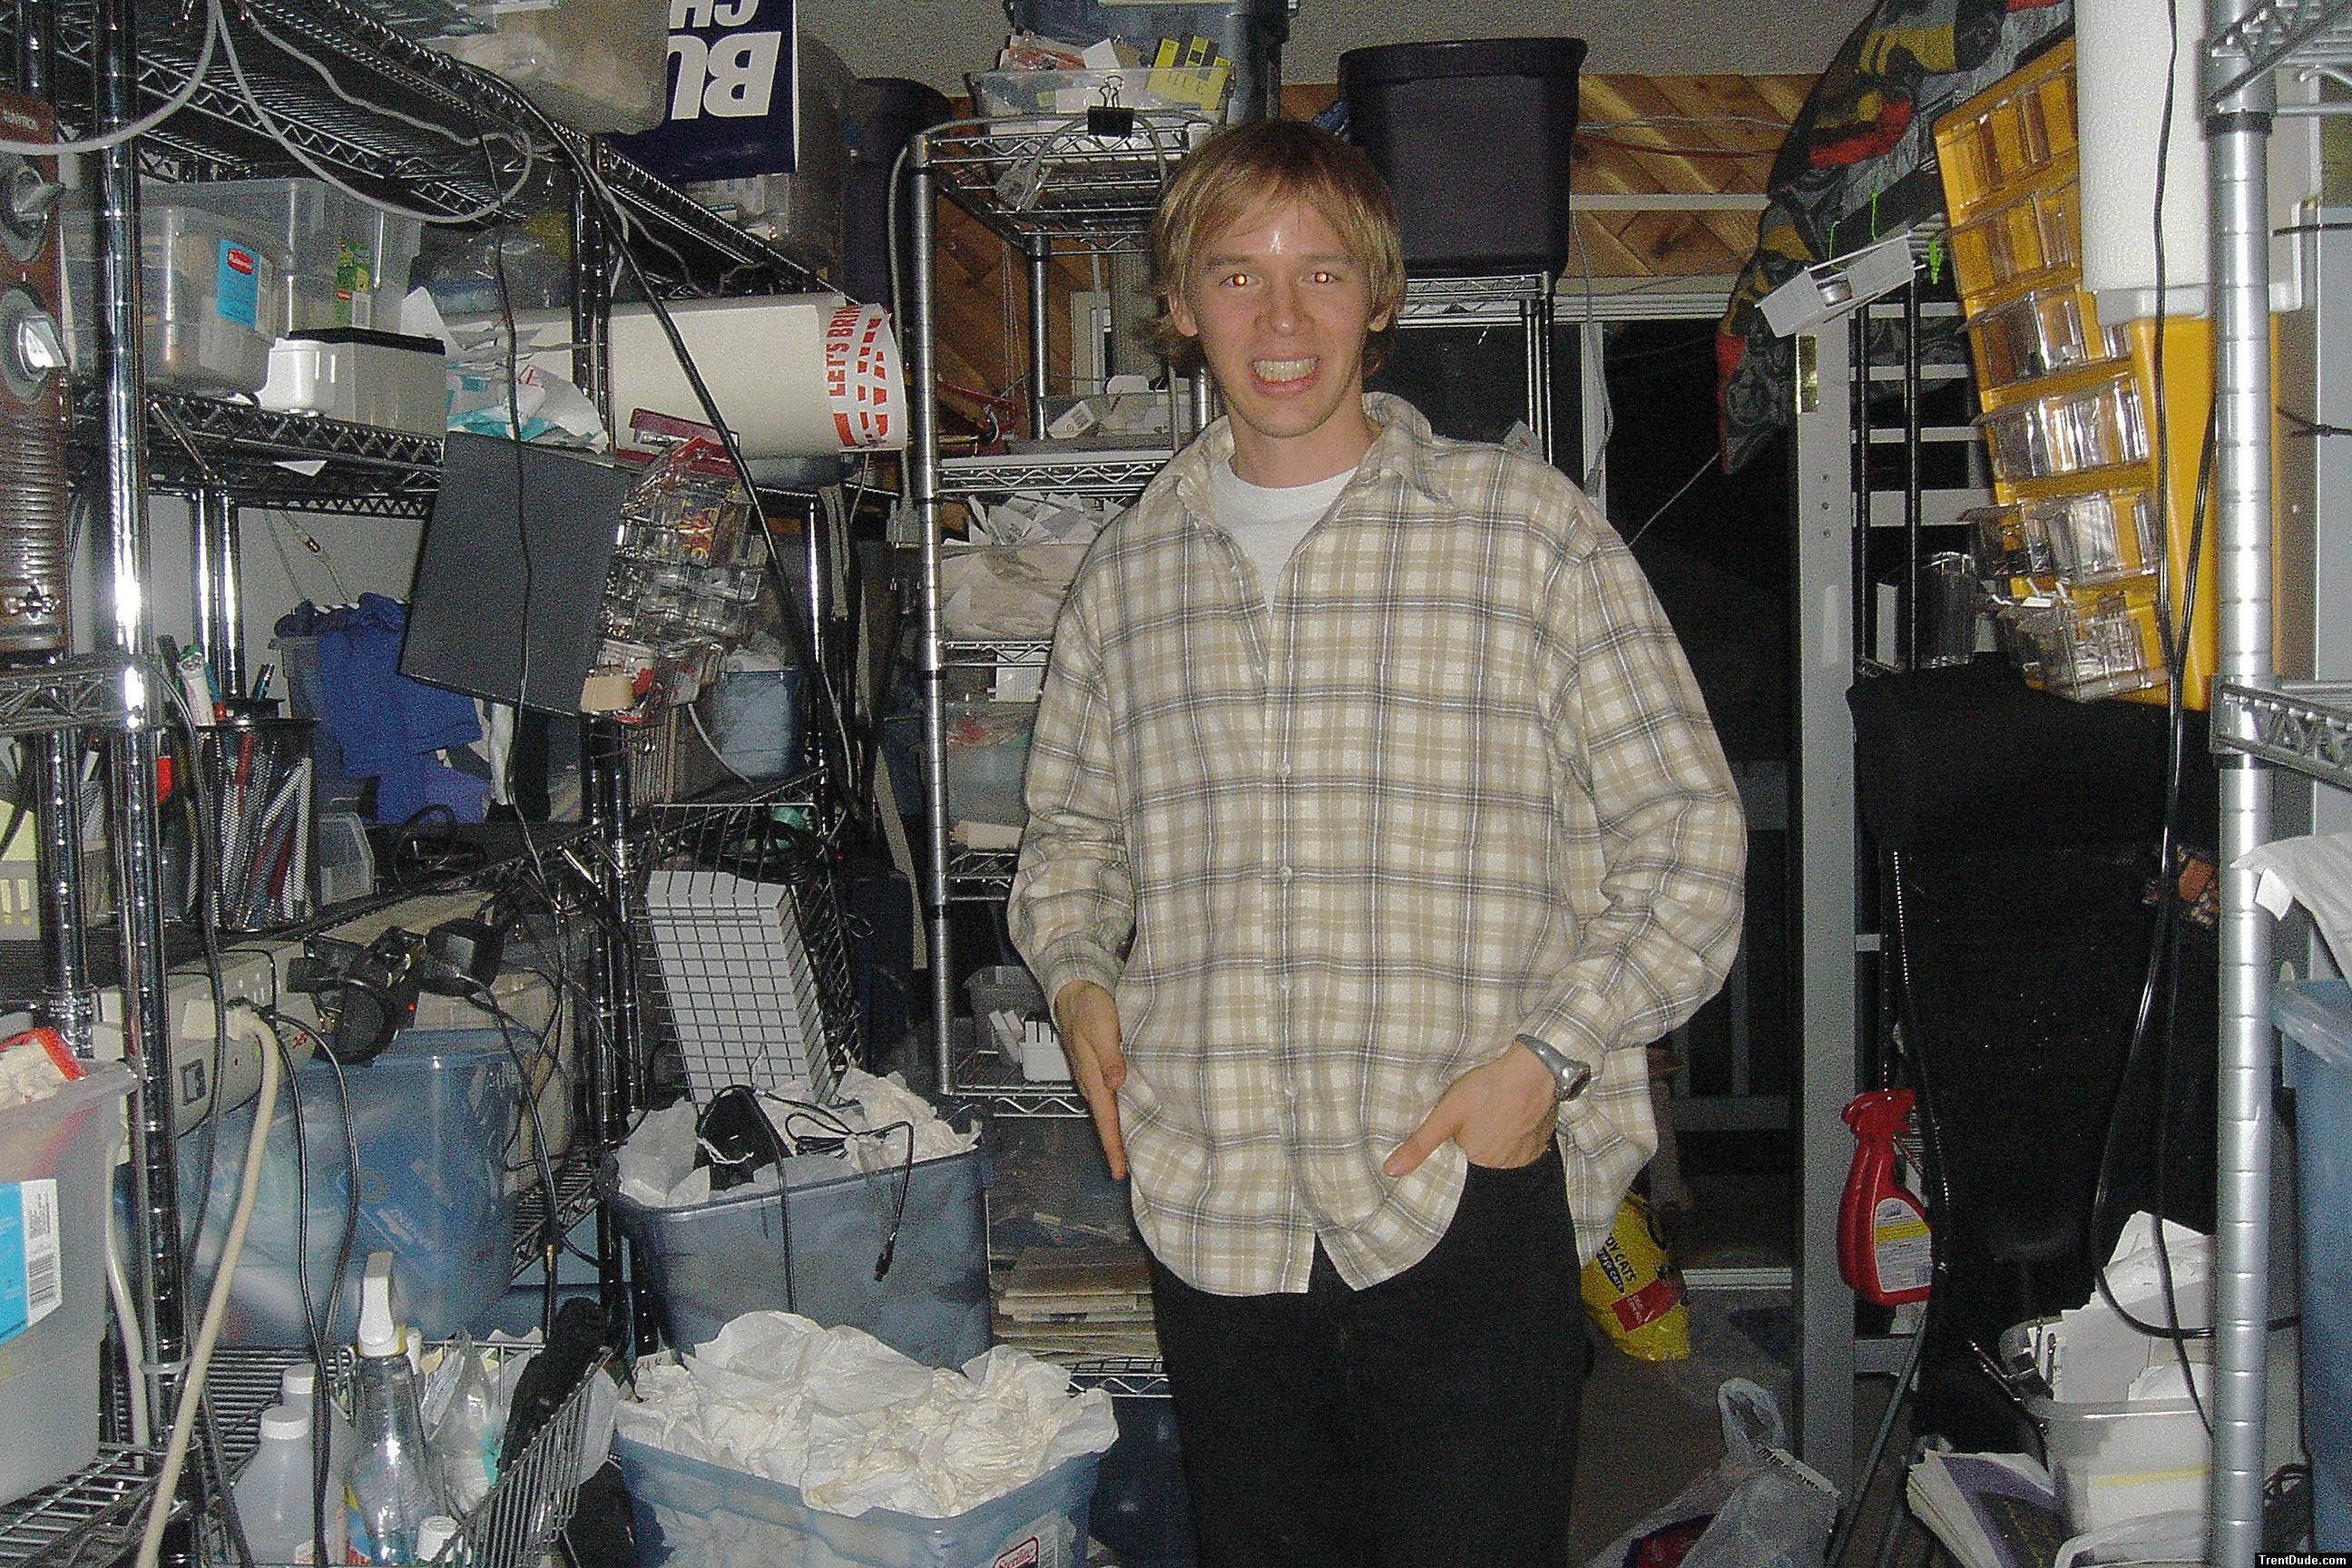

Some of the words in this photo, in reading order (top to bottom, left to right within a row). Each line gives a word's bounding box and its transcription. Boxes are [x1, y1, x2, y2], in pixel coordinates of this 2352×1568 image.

[668, 32, 781, 120] BU
[826, 341, 850, 397] LET'S
[1614, 1253, 1637, 1281] CATS
